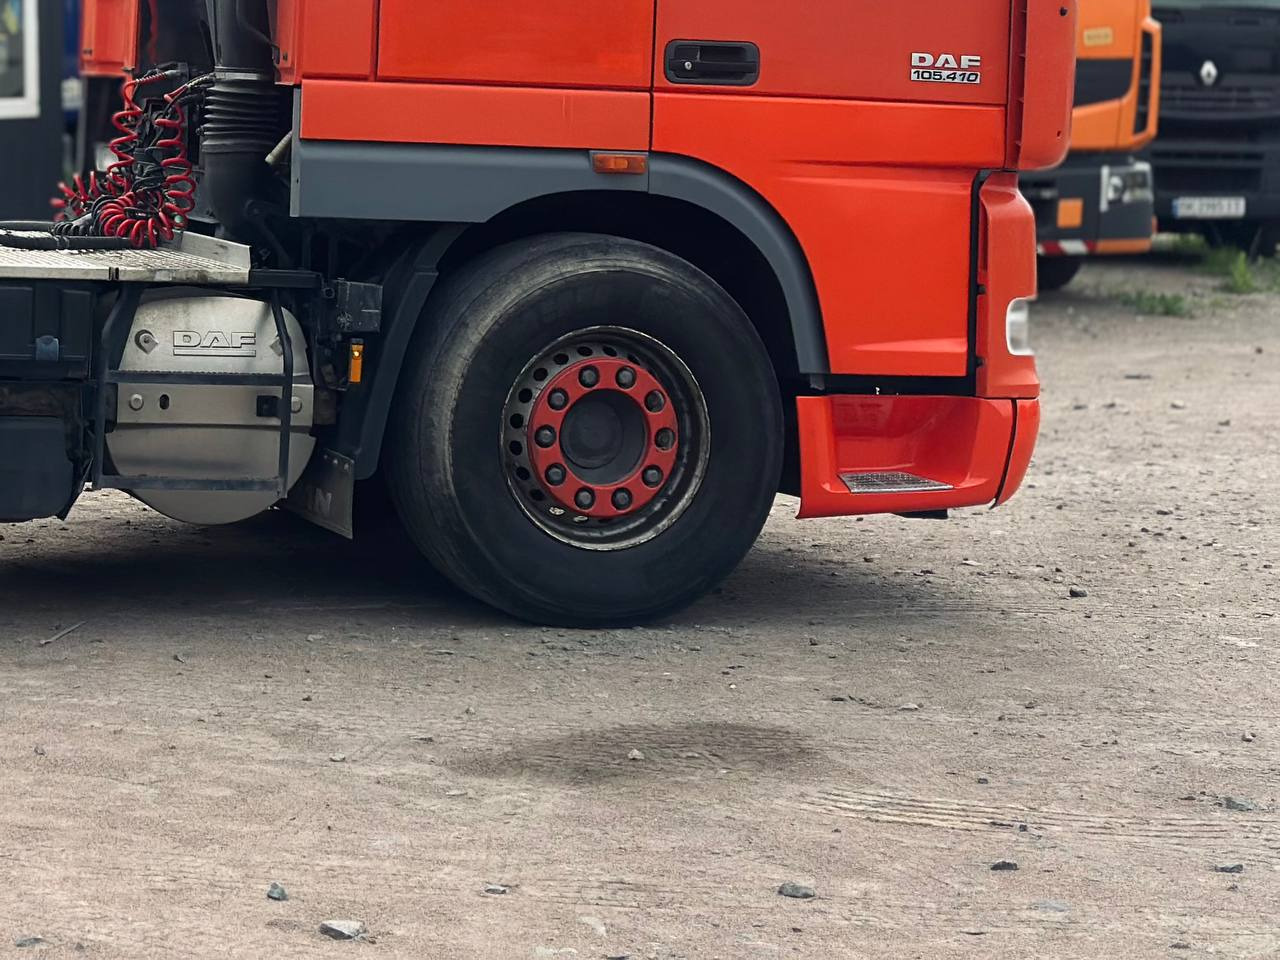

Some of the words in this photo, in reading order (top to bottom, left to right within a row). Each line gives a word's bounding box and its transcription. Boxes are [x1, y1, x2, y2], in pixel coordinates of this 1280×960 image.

[911, 52, 981, 69] DAF
[913, 70, 979, 82] 105.410
[173, 330, 256, 349] DAF
